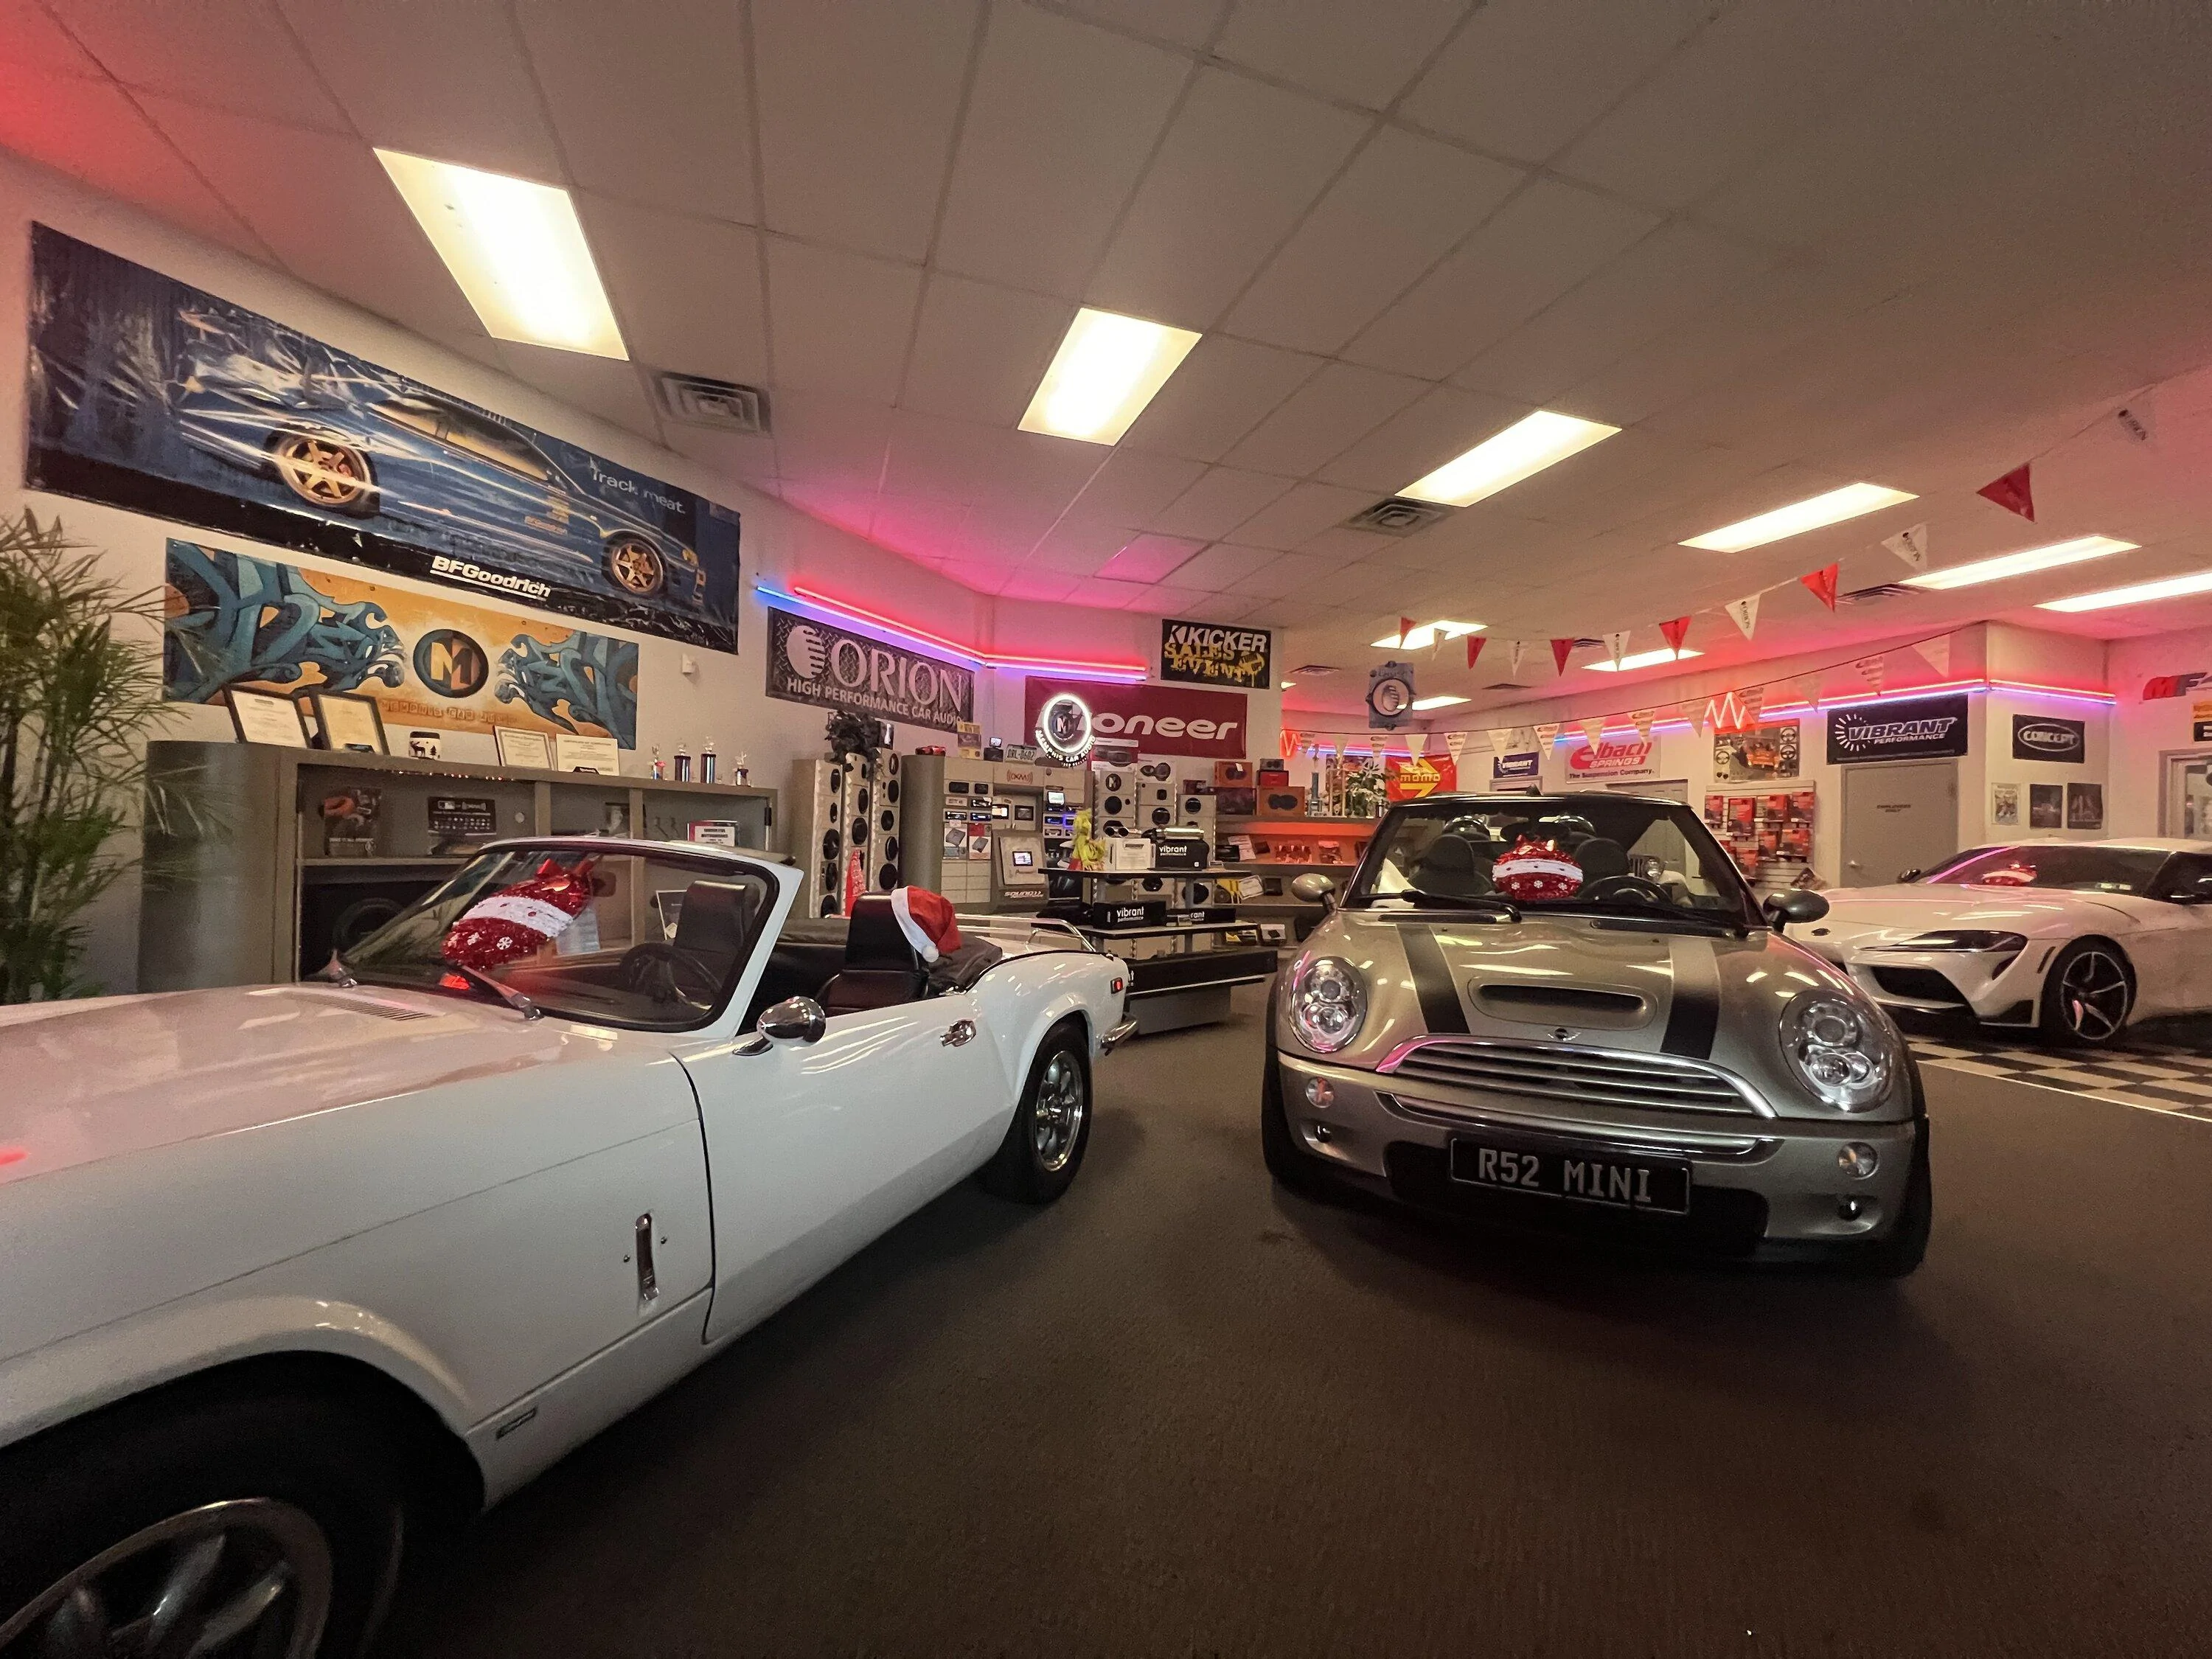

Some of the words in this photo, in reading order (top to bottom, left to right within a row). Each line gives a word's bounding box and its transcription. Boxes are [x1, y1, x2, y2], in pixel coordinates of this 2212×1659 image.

[590, 459, 638, 495] Track
[431, 555, 552, 599] BFGoodrich
[1187, 627, 1267, 653] KICKER
[831, 639, 962, 712] ORION
[786, 676, 821, 698] HIGH
[825, 686, 909, 716] PERFORMANCE
[911, 706, 931, 720] CAR
[1849, 717, 1955, 741] VIBRANT
[1874, 733, 1946, 745] PERFORMANCE
[2023, 730, 2076, 745] CONCEPT
[1582, 771, 1618, 779] Suspension
[1589, 757, 1641, 769] SPRINGS
[1159, 844, 1188, 853] vibrant
[1117, 905, 1144, 917] vibrant
[1478, 1147, 1540, 1188] R52
[1563, 1159, 1652, 1203] MINI
